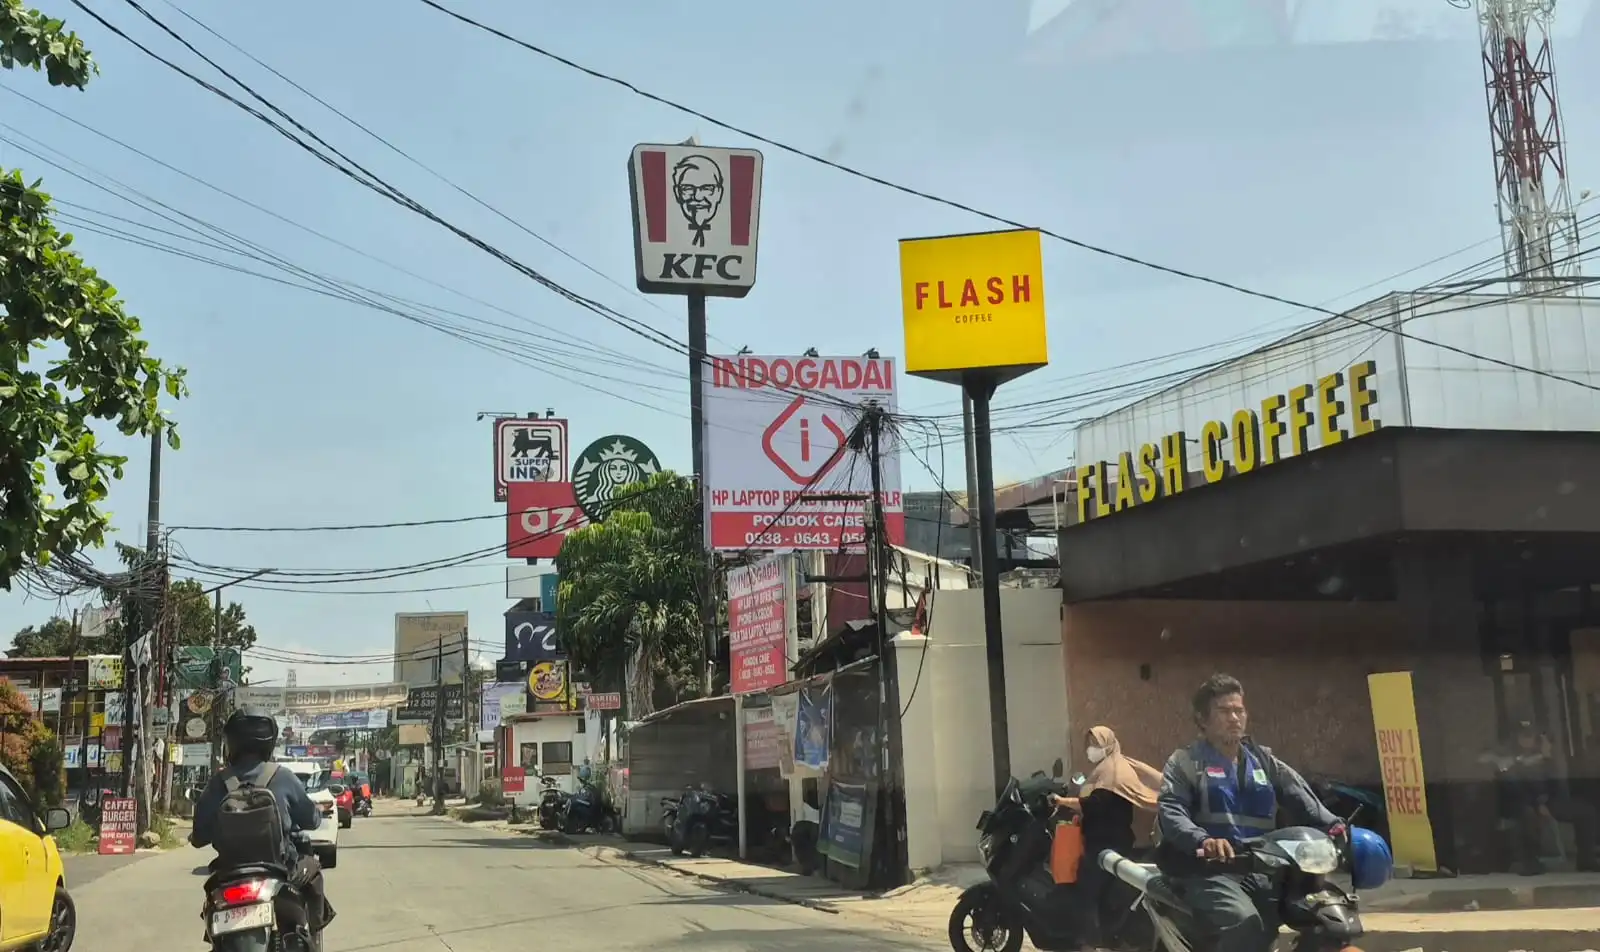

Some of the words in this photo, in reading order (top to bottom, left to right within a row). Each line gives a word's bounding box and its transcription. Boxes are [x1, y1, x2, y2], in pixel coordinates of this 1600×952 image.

[659, 254, 743, 281] KFC
[915, 274, 1031, 311] FLASH
[954, 313, 993, 324] COFFEE
[713, 359, 893, 391] INDOGADAI
[1076, 431, 1186, 523] FLASH
[1201, 360, 1382, 483] COFFEE
[515, 458, 550, 466] SUPER
[712, 490, 729, 506] HP
[732, 490, 780, 506] LAPTOP
[752, 514, 819, 527] PONDOK
[823, 514, 865, 528] CABE
[794, 533, 830, 545] 0643
[1378, 729, 1404, 754] BUY
[1408, 729, 1415, 754] 1
[1383, 756, 1406, 784] GET
[1412, 756, 1419, 783] 1
[104, 800, 134, 810] CAFFE
[1387, 786, 1423, 815] FREE
[102, 811, 135, 821] BURGER
